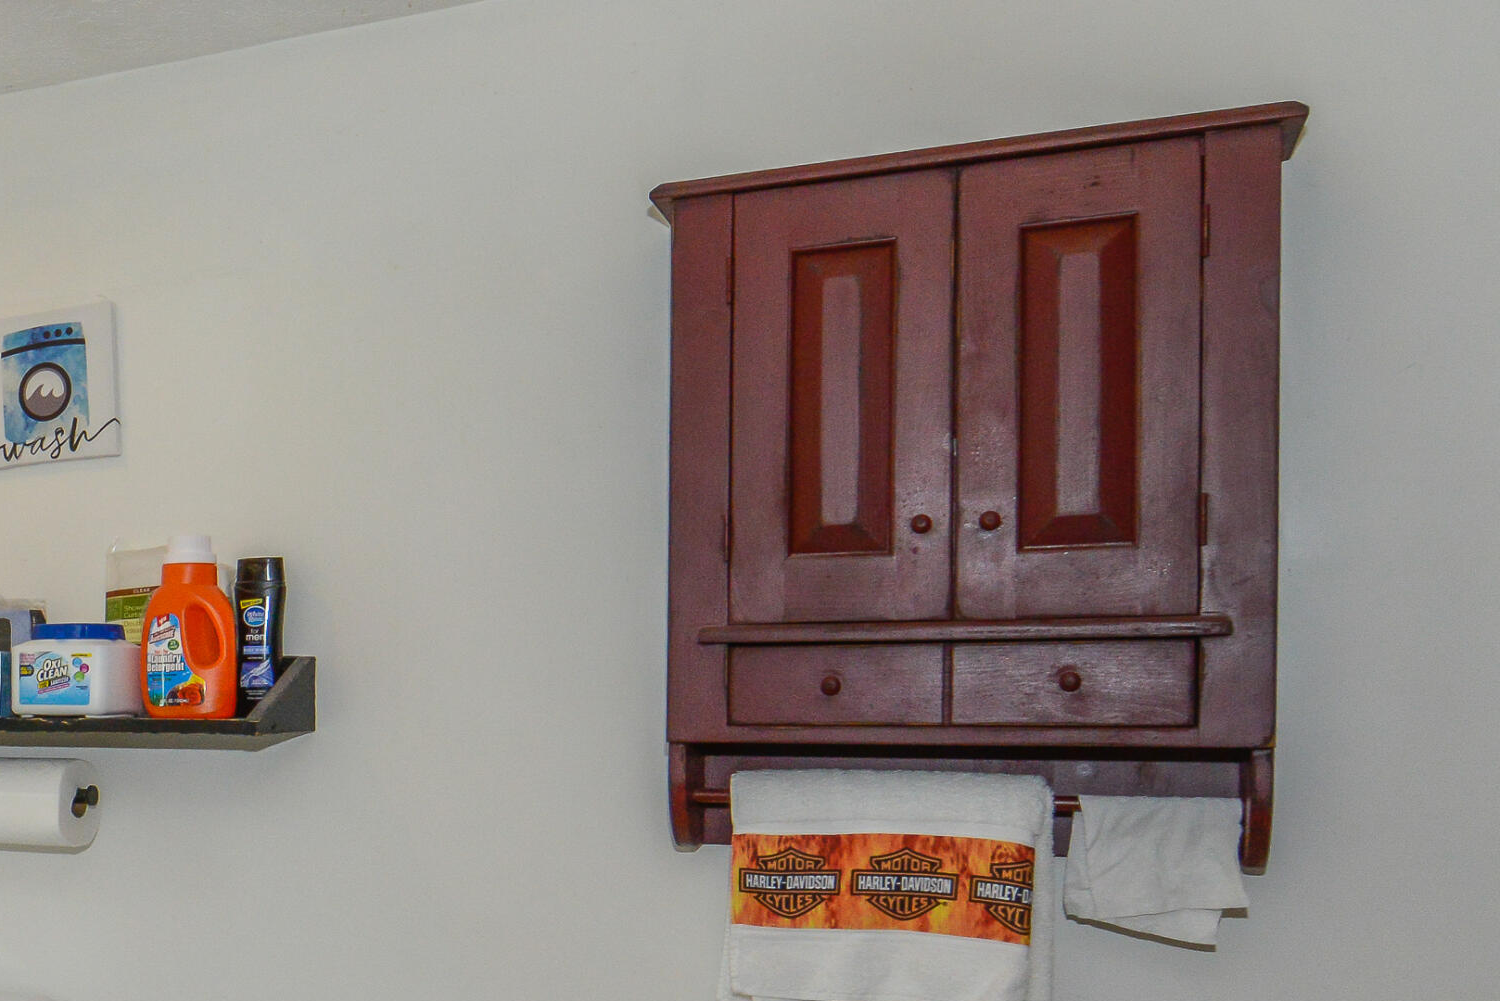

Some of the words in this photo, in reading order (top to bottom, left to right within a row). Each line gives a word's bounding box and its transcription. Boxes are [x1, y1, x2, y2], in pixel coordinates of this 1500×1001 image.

[37, 665, 68, 682] CLEAN
[766, 854, 815, 871] MOTOR
[880, 854, 932, 872] MOTOR
[745, 873, 836, 890] HARLEY-DAVIDSON
[1001, 866, 1032, 882] MOT
[857, 875, 953, 894] HARLEY-DAVIDSON
[977, 882, 1031, 904] HARLEY-D
[765, 894, 814, 913] CYCLES
[878, 895, 929, 915] CYCLES
